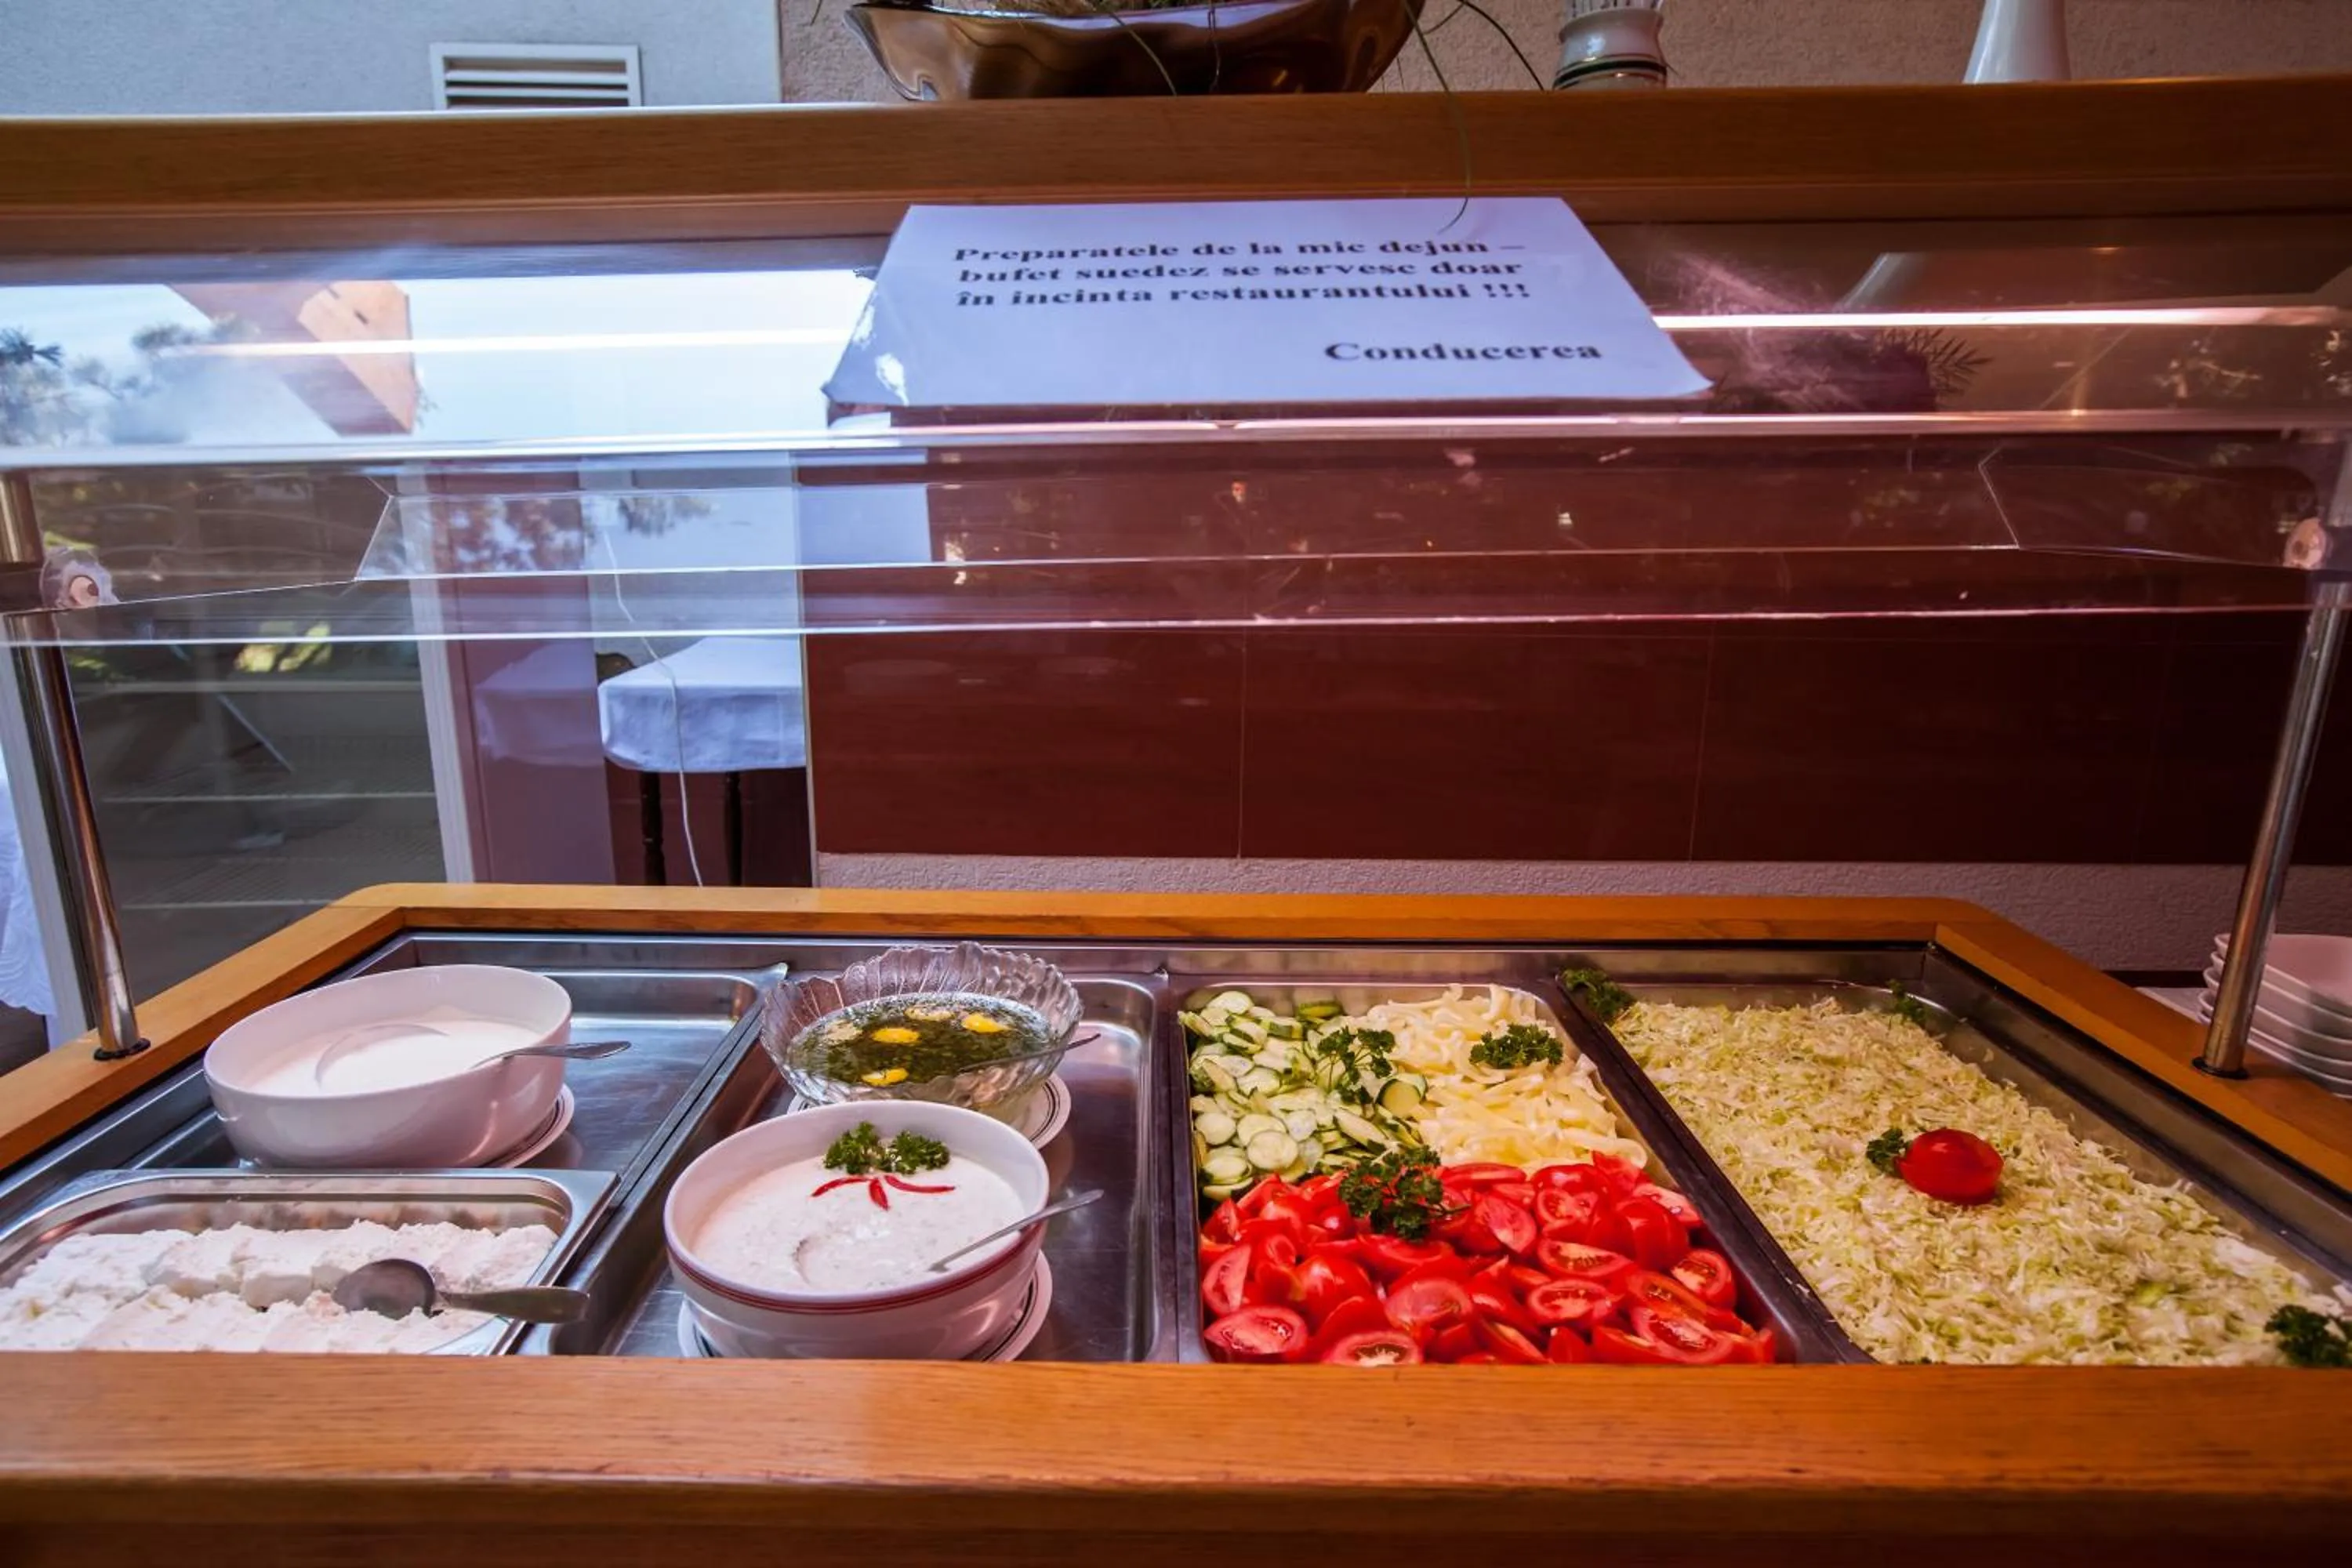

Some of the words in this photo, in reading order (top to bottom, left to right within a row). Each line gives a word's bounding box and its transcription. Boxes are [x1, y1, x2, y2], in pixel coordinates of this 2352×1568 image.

[954, 244, 1179, 262] Preparatele
[1192, 243, 1236, 256] de
[1250, 241, 1282, 254] la
[1298, 241, 1365, 254] mic
[1379, 241, 1488, 256] dejun
[959, 267, 1062, 282] bufet
[1075, 264, 1210, 279] suedez
[1221, 265, 1261, 278] se
[1273, 262, 1417, 276] servesc
[1430, 260, 1523, 274] doar
[956, 290, 996, 306] în
[1011, 289, 1152, 306] incinta
[1170, 284, 1471, 300] restaurantului
[1484, 283, 1531, 298] !!!
[1324, 343, 1603, 361] Conducerea
